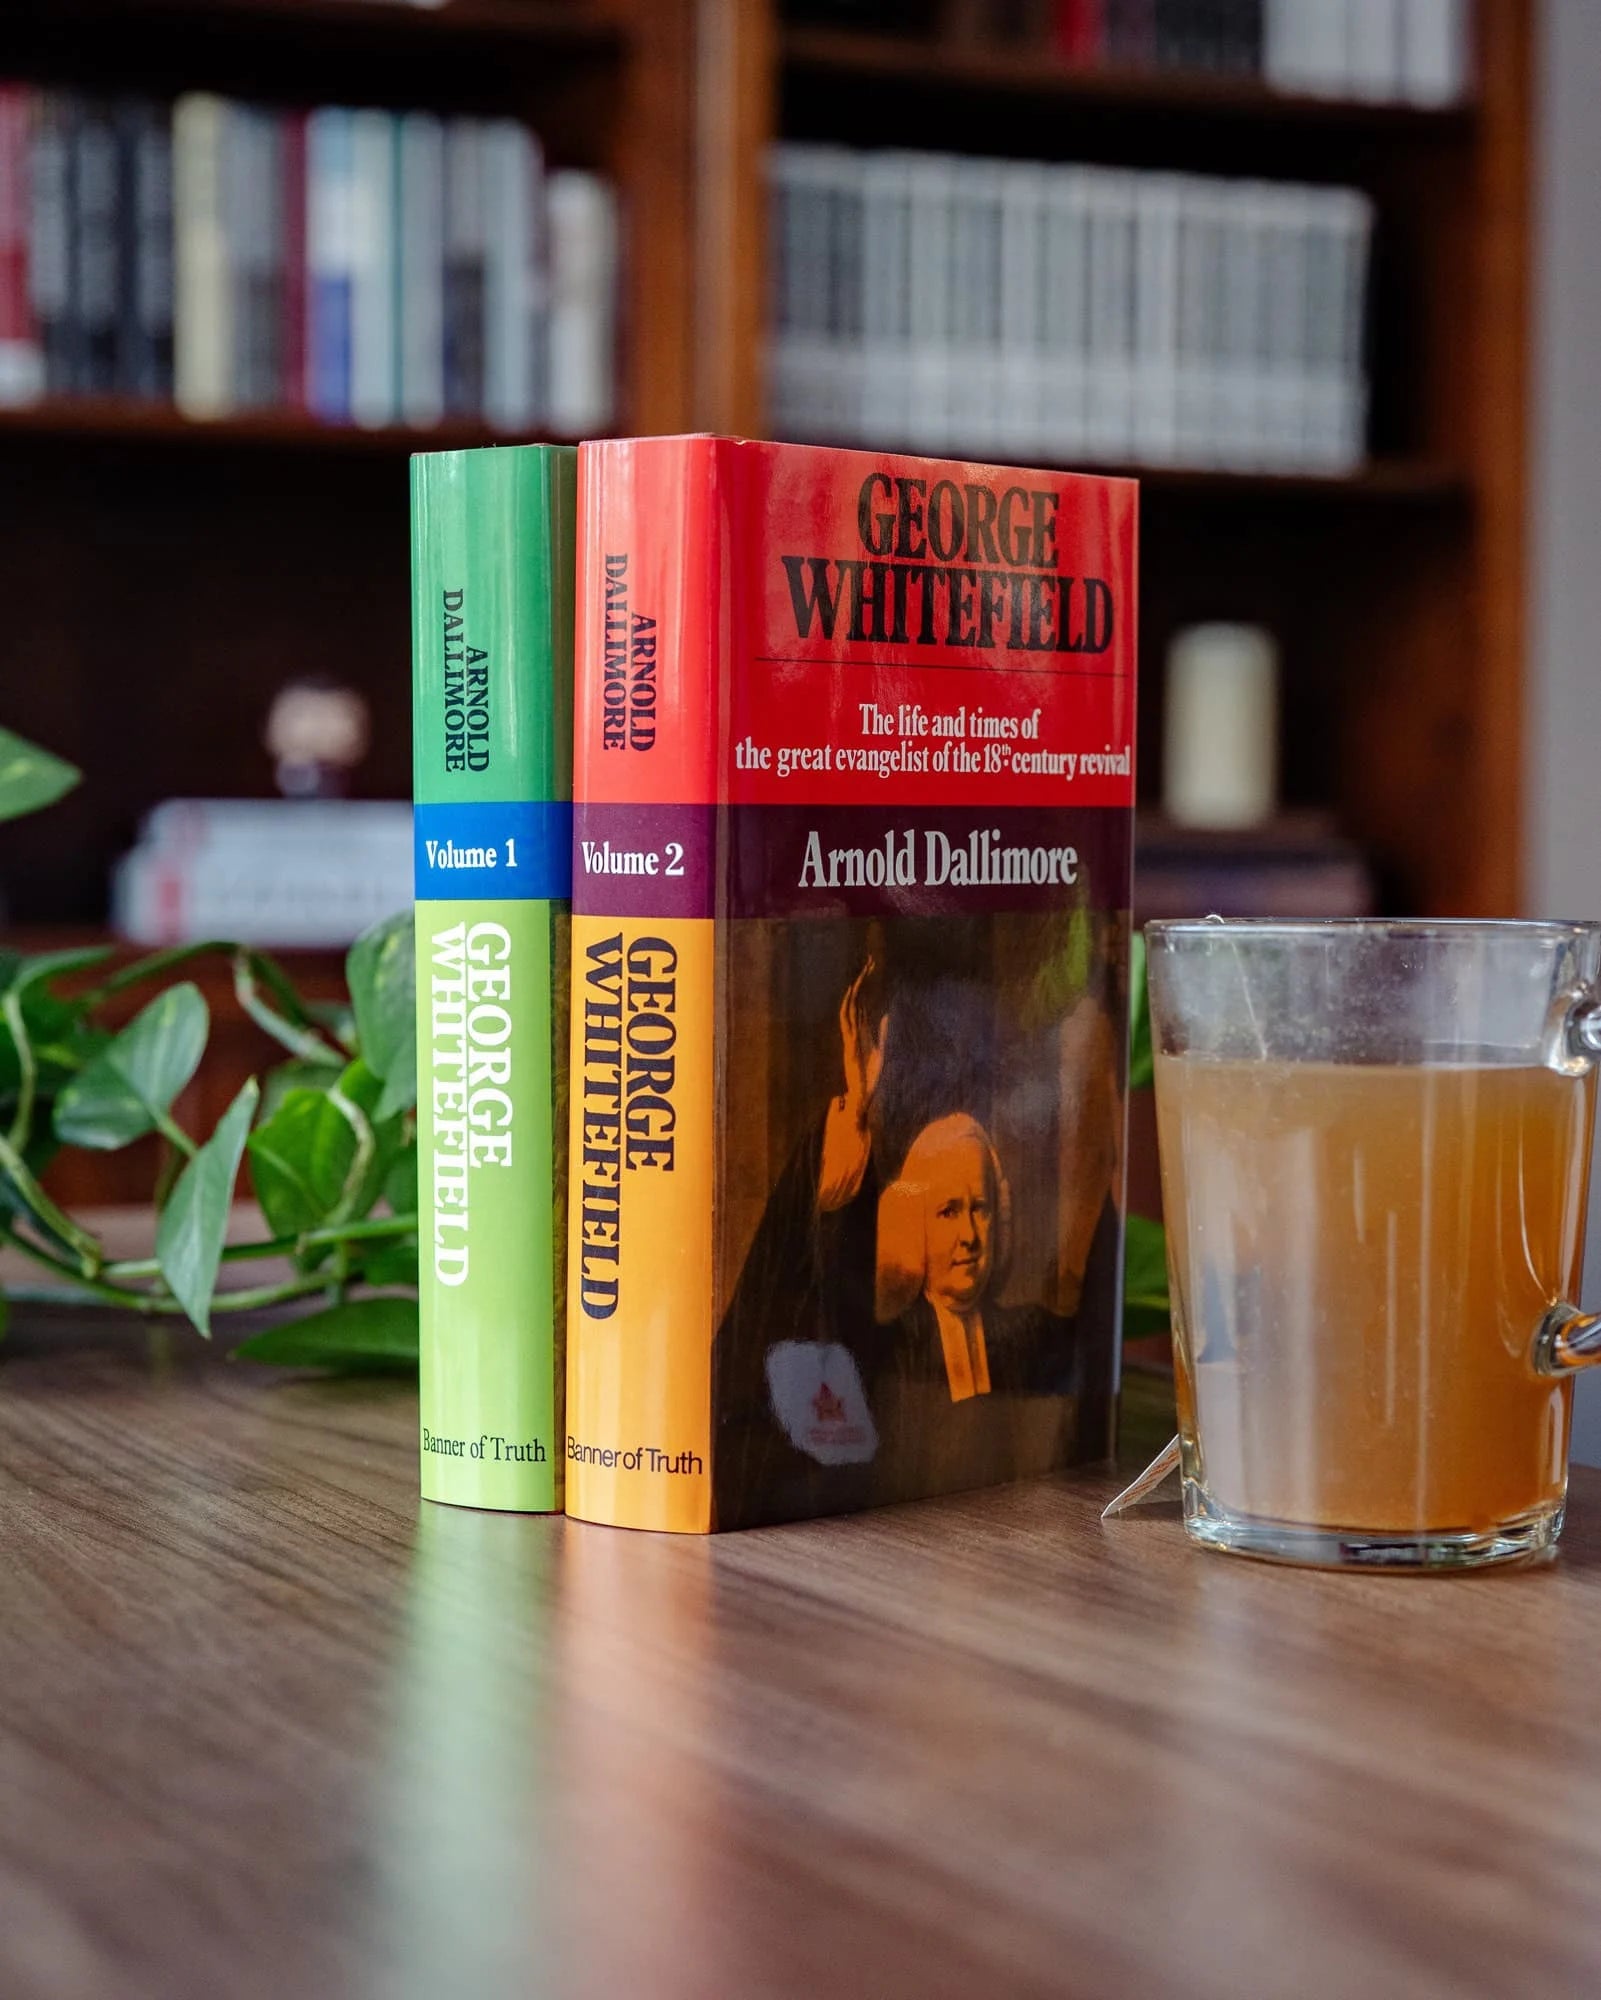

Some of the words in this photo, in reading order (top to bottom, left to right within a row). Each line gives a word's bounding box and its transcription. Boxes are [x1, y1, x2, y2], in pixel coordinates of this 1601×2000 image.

[858, 472, 1060, 569] GEORGE
[602, 553, 628, 751] DALLIMORE
[782, 555, 1114, 655] WHITEFIELD
[443, 588, 466, 773] DALLIMORE
[466, 645, 490, 772] ARNOLD
[629, 612, 657, 752] ARNOLD
[859, 703, 895, 736] The
[898, 704, 929, 737] life
[931, 706, 966, 738] and
[969, 706, 1019, 740] times
[1021, 708, 1042, 740] of
[735, 736, 772, 770] the
[776, 744, 832, 778] great
[835, 740, 929, 779] evangelist
[932, 740, 953, 773] of
[952, 742, 981, 773] the
[1011, 749, 1078, 782] century
[1079, 744, 1131, 777] revival
[425, 840, 498, 869] Volume
[504, 838, 518, 868] 1
[581, 840, 659, 876] Volume
[664, 842, 685, 877] 2
[798, 828, 917, 888] Arnold
[924, 828, 1079, 886] Dallimore
[465, 921, 514, 1168] GEORGE
[624, 935, 678, 1172] GEORGE
[431, 920, 469, 1287] WHITEFIELD
[580, 931, 624, 1320] WHITEFIELD
[423, 1428, 466, 1458] Banner
[470, 1434, 488, 1460] of
[489, 1436, 547, 1463] Truth
[567, 1435, 621, 1468] Banner
[622, 1446, 644, 1471] of
[644, 1447, 704, 1476] Truth
